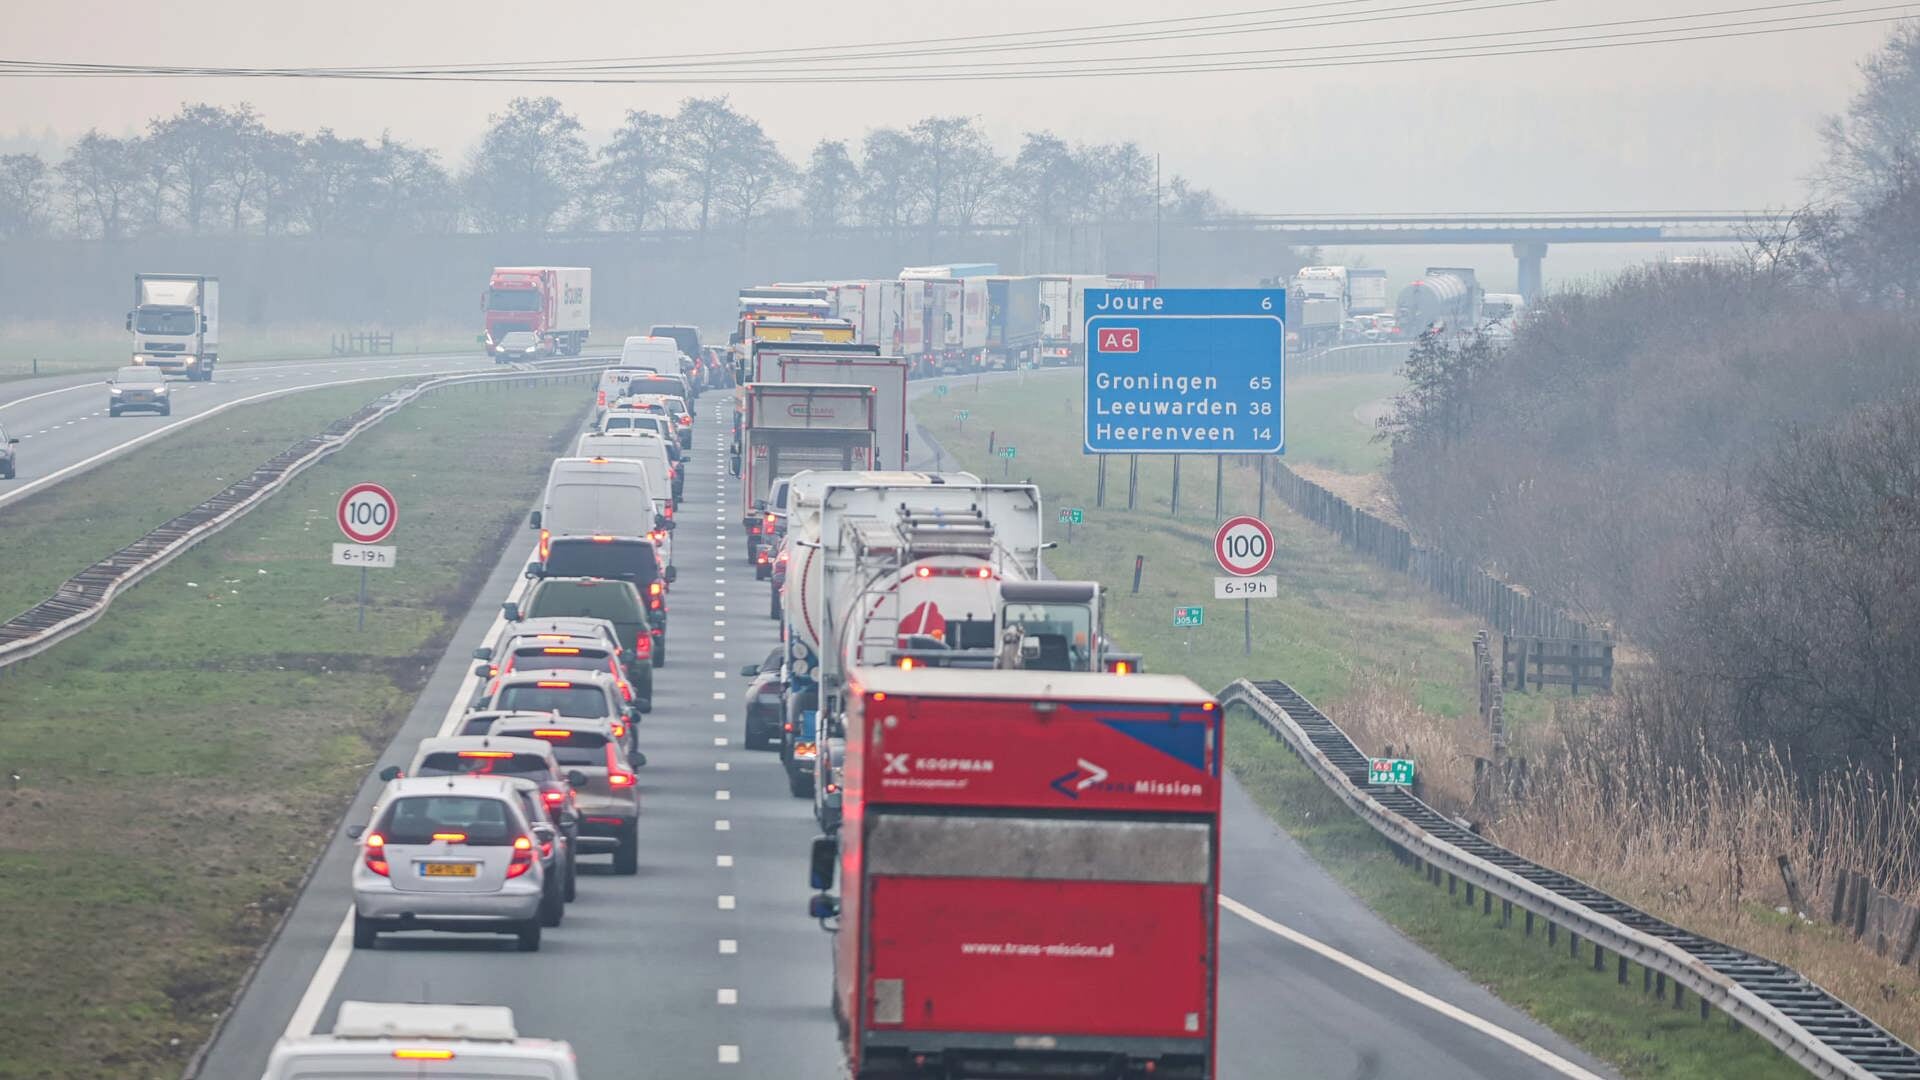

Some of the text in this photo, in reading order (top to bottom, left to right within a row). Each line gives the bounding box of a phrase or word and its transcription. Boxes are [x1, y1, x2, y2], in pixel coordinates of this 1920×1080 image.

[1096, 293, 1273, 310] Joure 6
[1104, 333, 1134, 348] A6
[1096, 372, 1272, 395] Groningen 65
[1096, 398, 1272, 415] Leeuwarden 38
[1096, 423, 1272, 441] Heerenveen 14
[350, 502, 387, 526] 100
[1226, 535, 1265, 558] 100
[915, 758, 994, 772] KOOPMAN
[961, 942, 1115, 958] www.trans-mission.nl
